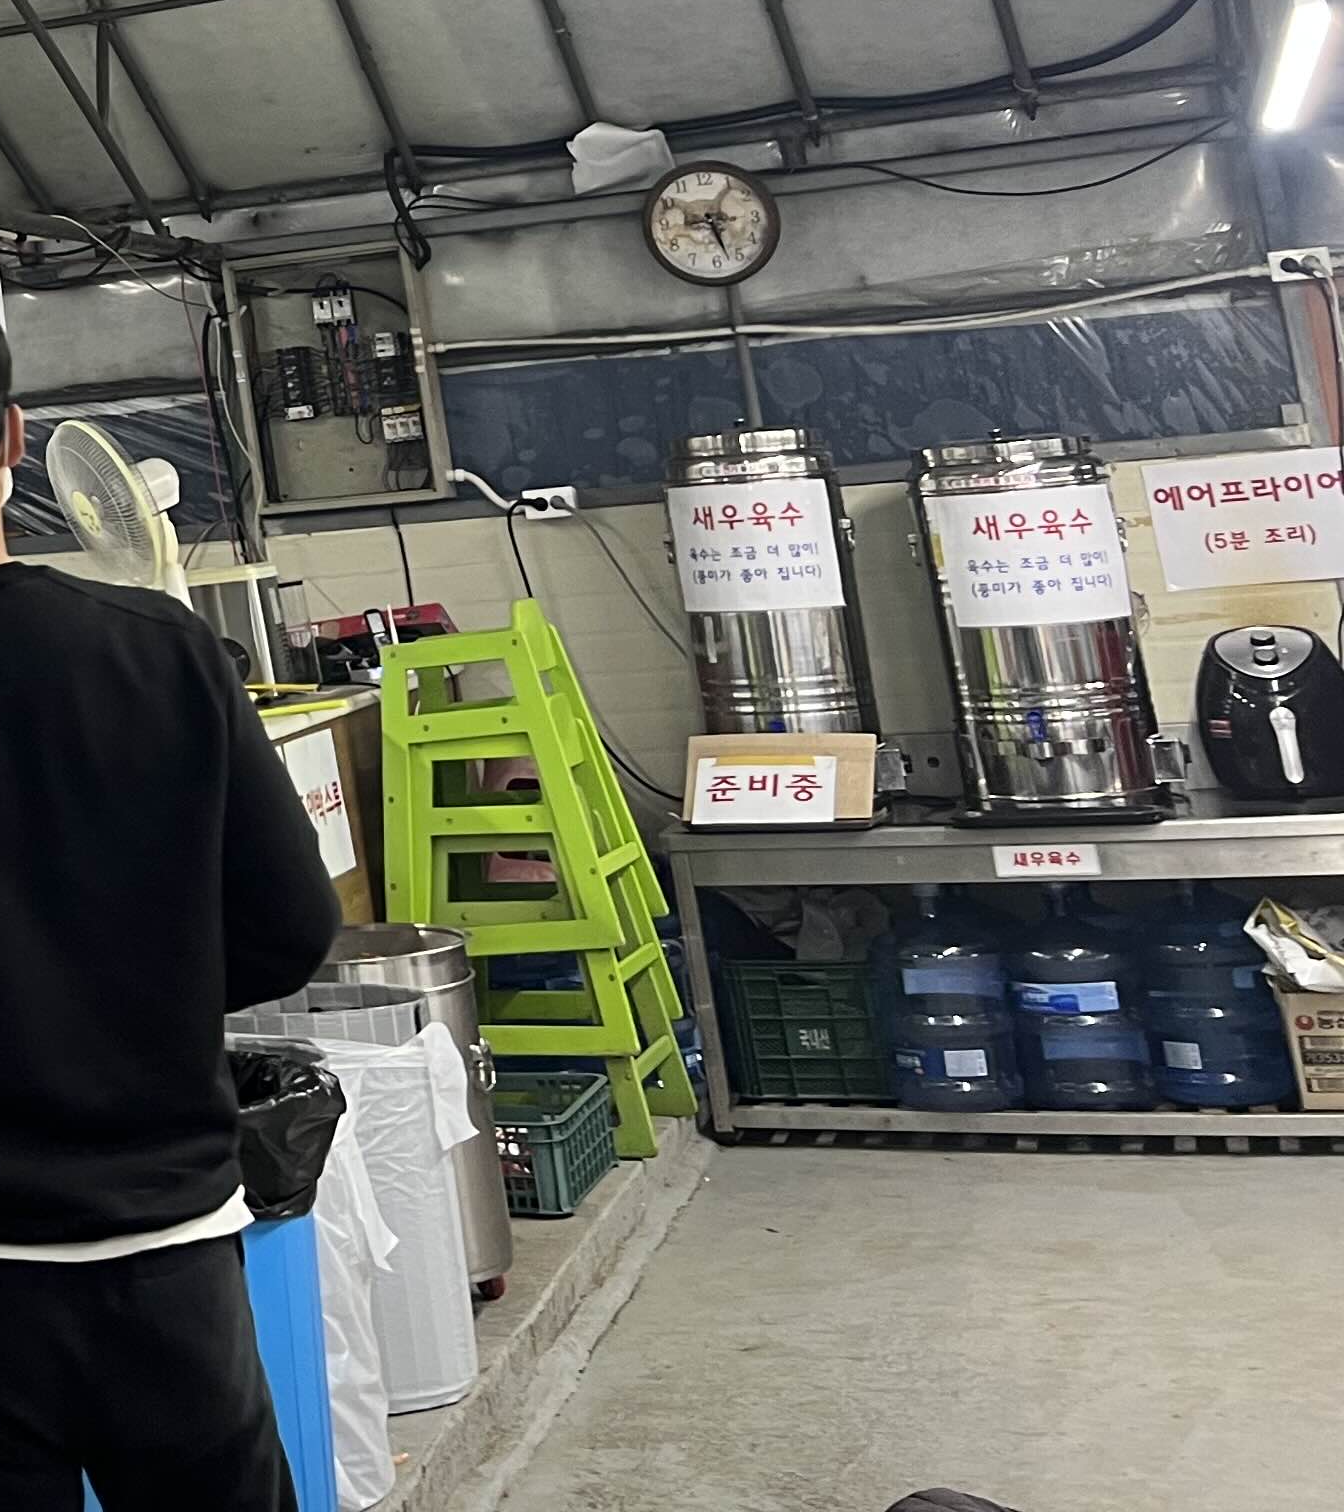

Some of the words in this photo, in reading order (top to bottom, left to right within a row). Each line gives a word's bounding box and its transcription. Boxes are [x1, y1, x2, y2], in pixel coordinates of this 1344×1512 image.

[696, 173, 713, 186] 12
[725, 176, 731, 188] 1
[675, 180, 687, 193] 11
[740, 189, 751, 201] 2
[661, 197, 674, 209] 10
[750, 210, 760, 223] 3
[659, 217, 669, 231] 9
[747, 231, 757, 244] 4
[671, 239, 679, 251] 8
[688, 253, 696, 266] 7
[734, 248, 744, 261] 5
[712, 255, 722, 268] 6
[692, 502, 803, 531] 새우육수
[972, 508, 1093, 541] 새우육수
[1205, 532, 1250, 553] (5분
[1264, 524, 1316, 545] 조리)
[689, 547, 722, 562] 육수는
[730, 546, 757, 560] 조금
[767, 544, 779, 555] 더
[968, 559, 1009, 574] 육수는
[1021, 556, 1049, 570] 조금
[1060, 553, 1072, 565] 더
[740, 567, 768, 583] 좋아
[777, 564, 822, 580] 집니다)
[1032, 578, 1061, 595] 좋아
[1071, 574, 1112, 591] 집니다)
[706, 774, 823, 802] 준비중
[1014, 851, 1081, 867] 새우육수
